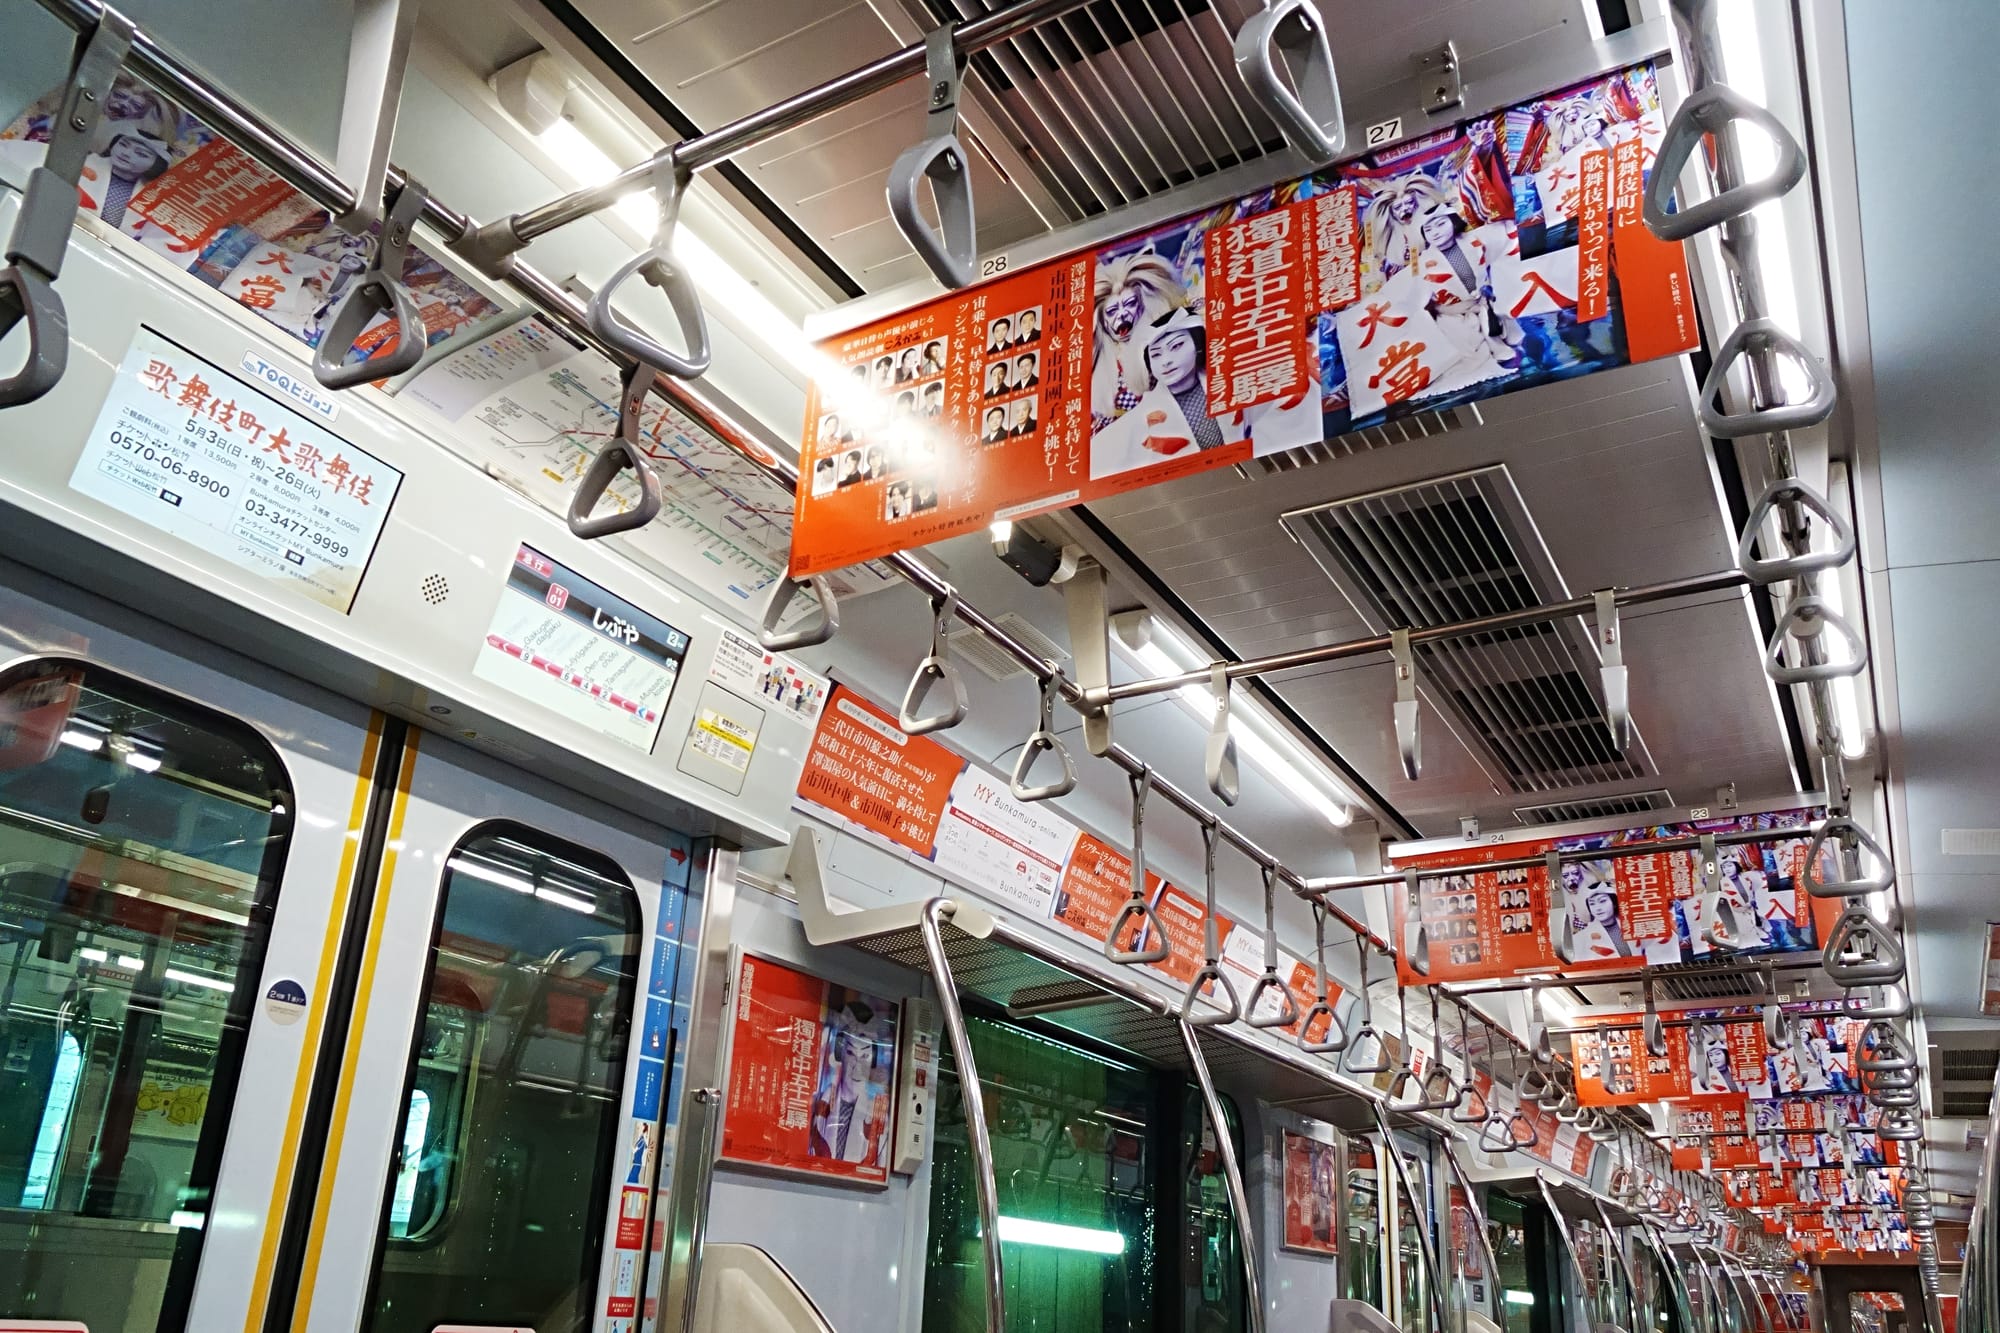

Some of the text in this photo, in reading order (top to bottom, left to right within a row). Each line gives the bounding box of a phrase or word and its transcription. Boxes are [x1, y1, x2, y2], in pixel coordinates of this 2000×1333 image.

[1370, 121, 1399, 144] 27
[1616, 143, 1640, 228] 歌舞伎町に
[983, 256, 1008, 277] 28
[1509, 271, 1579, 319] 入
[137, 359, 375, 505] 歌舞伎町大歌舞伎
[109, 431, 230, 498] 0570-06-8900
[244, 498, 349, 559] 03-3477-9999
[523, 552, 545, 572] 急行
[548, 593, 563, 607] 01
[592, 607, 640, 646] しぶや
[973, 782, 995, 804] MY
[994, 796, 1037, 828] Bunkamura
[1692, 808, 1708, 819] 23
[1491, 834, 1504, 843] 24
[999, 880, 1041, 908] Bunkamura
[1624, 854, 1667, 938] 道中五十三驛
